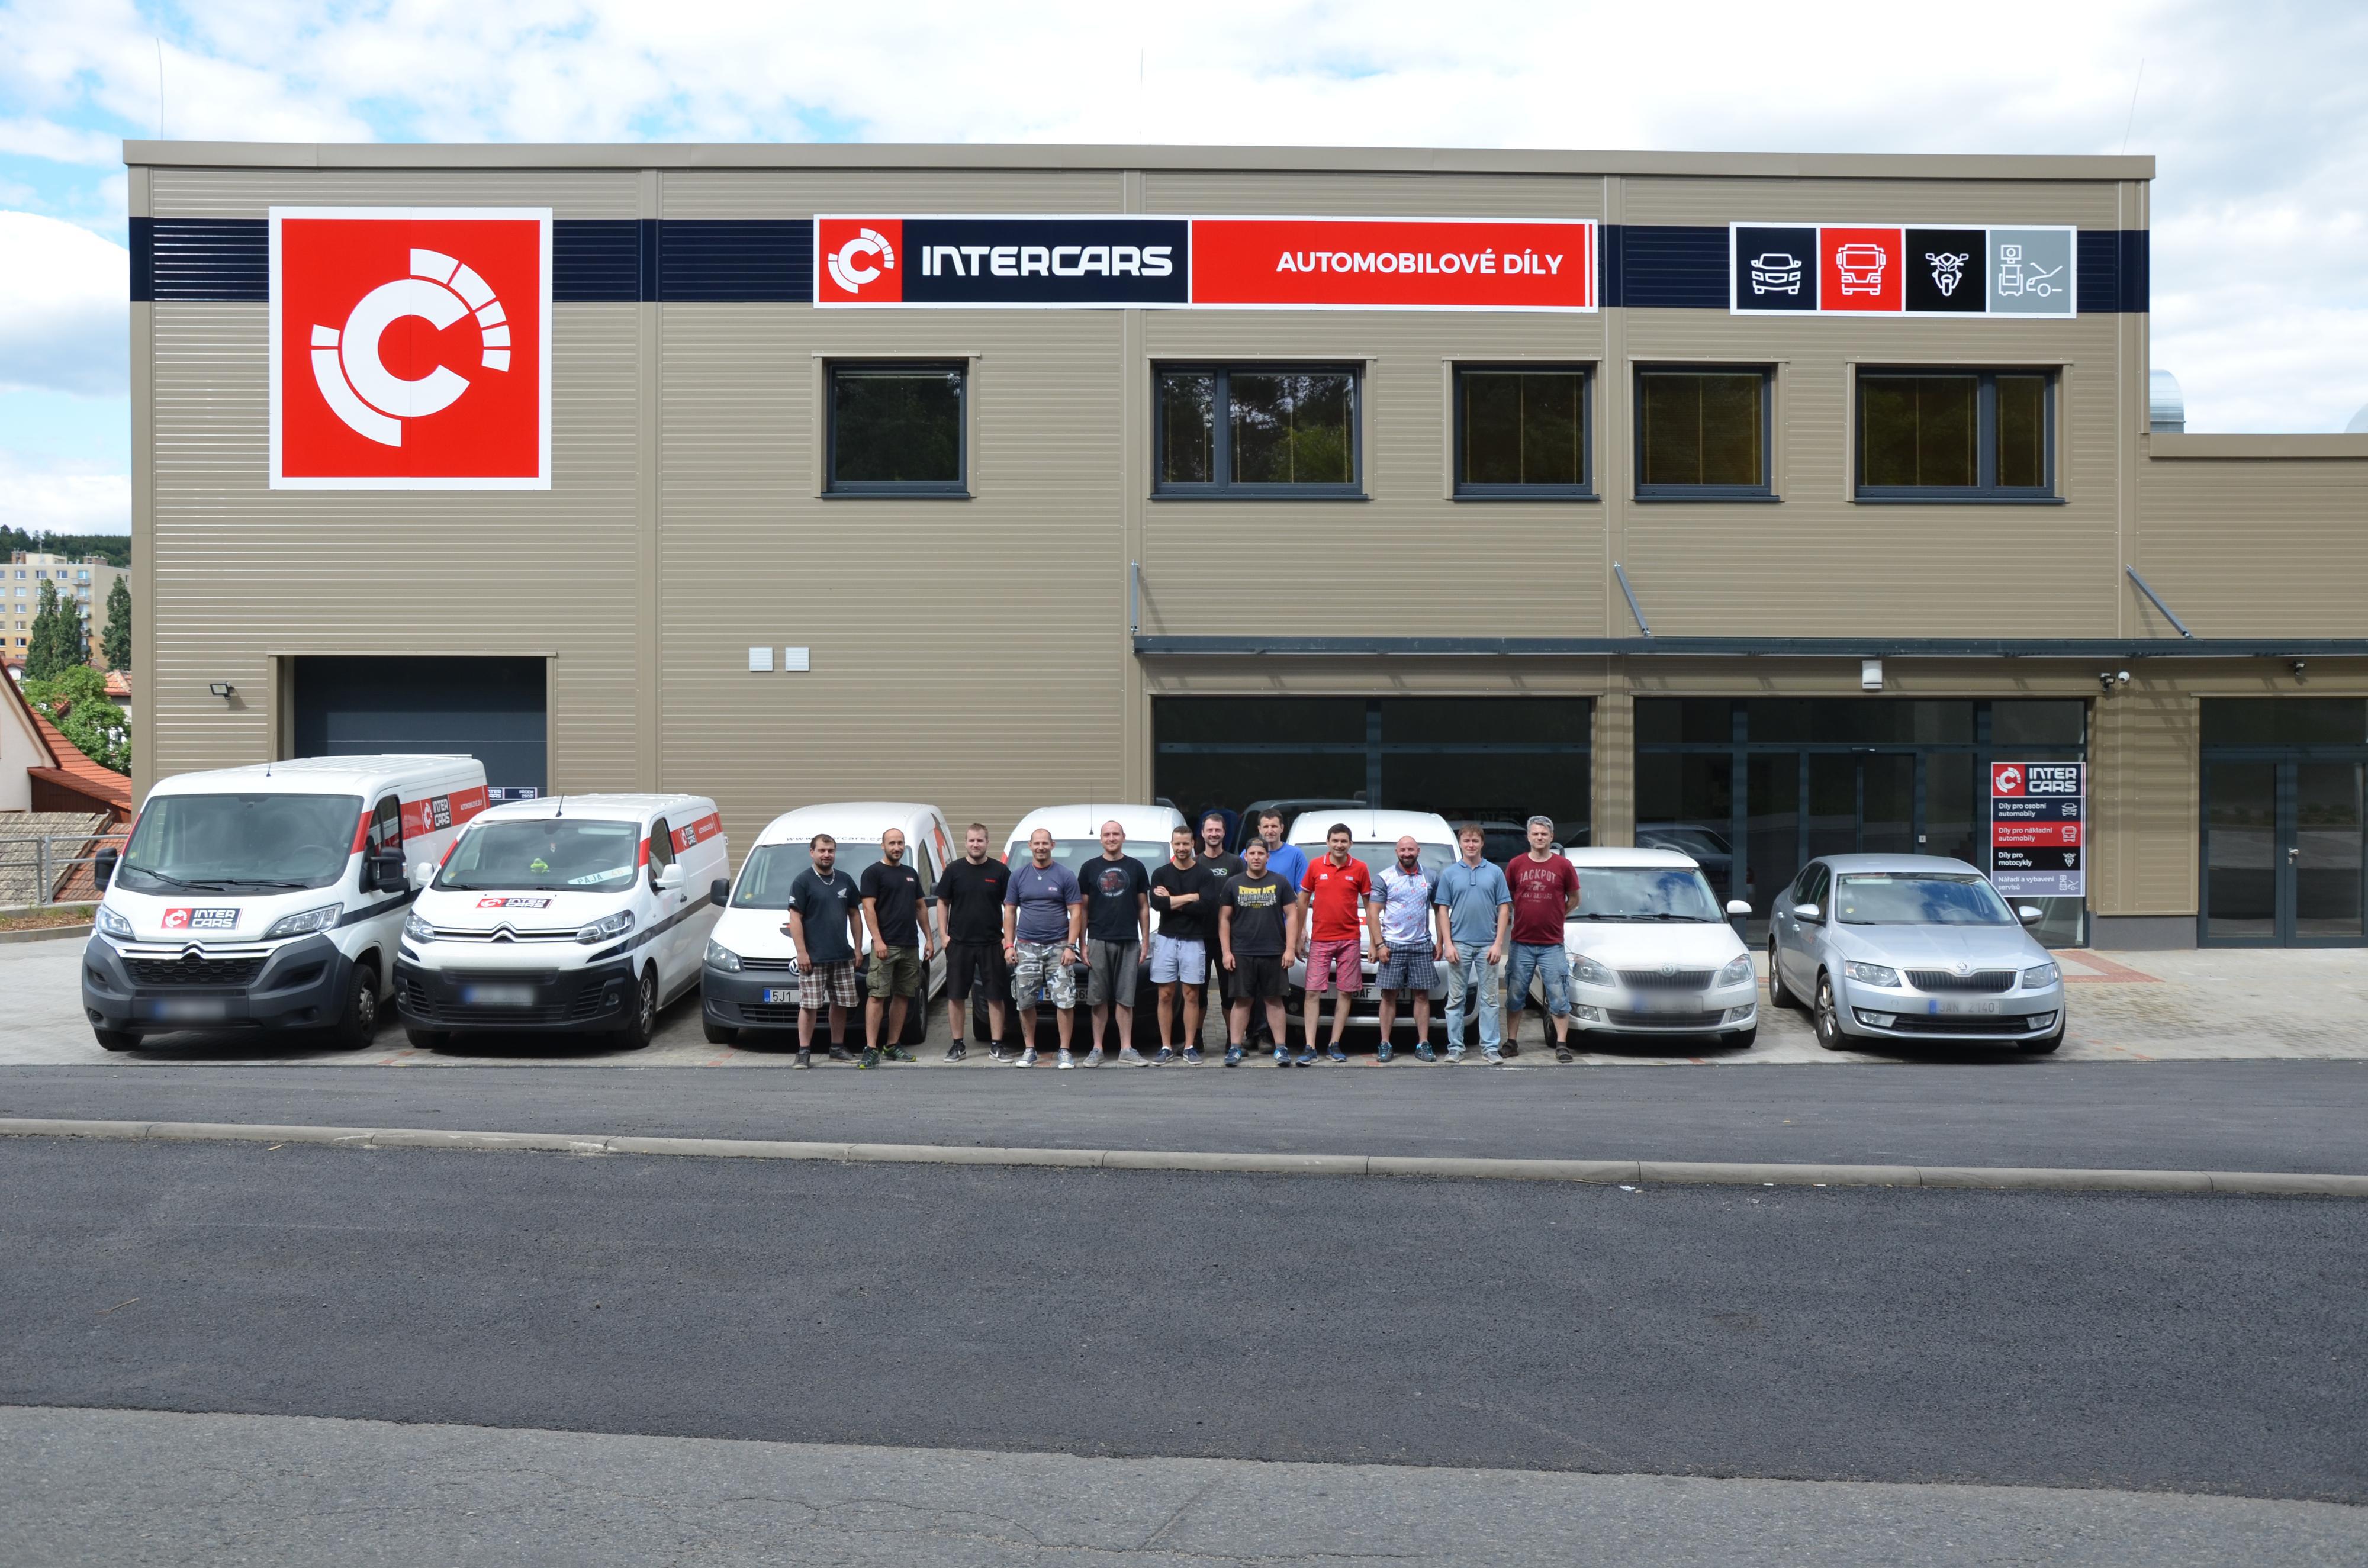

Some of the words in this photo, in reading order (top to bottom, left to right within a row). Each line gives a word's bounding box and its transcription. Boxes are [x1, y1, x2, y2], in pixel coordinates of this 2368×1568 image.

[923, 246, 1173, 276] INTERCARS
[1276, 249, 1496, 274] AUTOMOBILOVÉ
[1504, 249, 1563, 275] DÍLY
[2029, 768, 2077, 780] INTER
[2029, 781, 2077, 793] CARS
[432, 799, 449, 813] INTER
[435, 812, 450, 827] CARS
[1520, 869, 1556, 884] JACKPOT
[1238, 884, 1276, 901] EVERLAST
[194, 909, 236, 918] INTER
[192, 918, 233, 928] CARS
[773, 991, 791, 1002] 5J1
